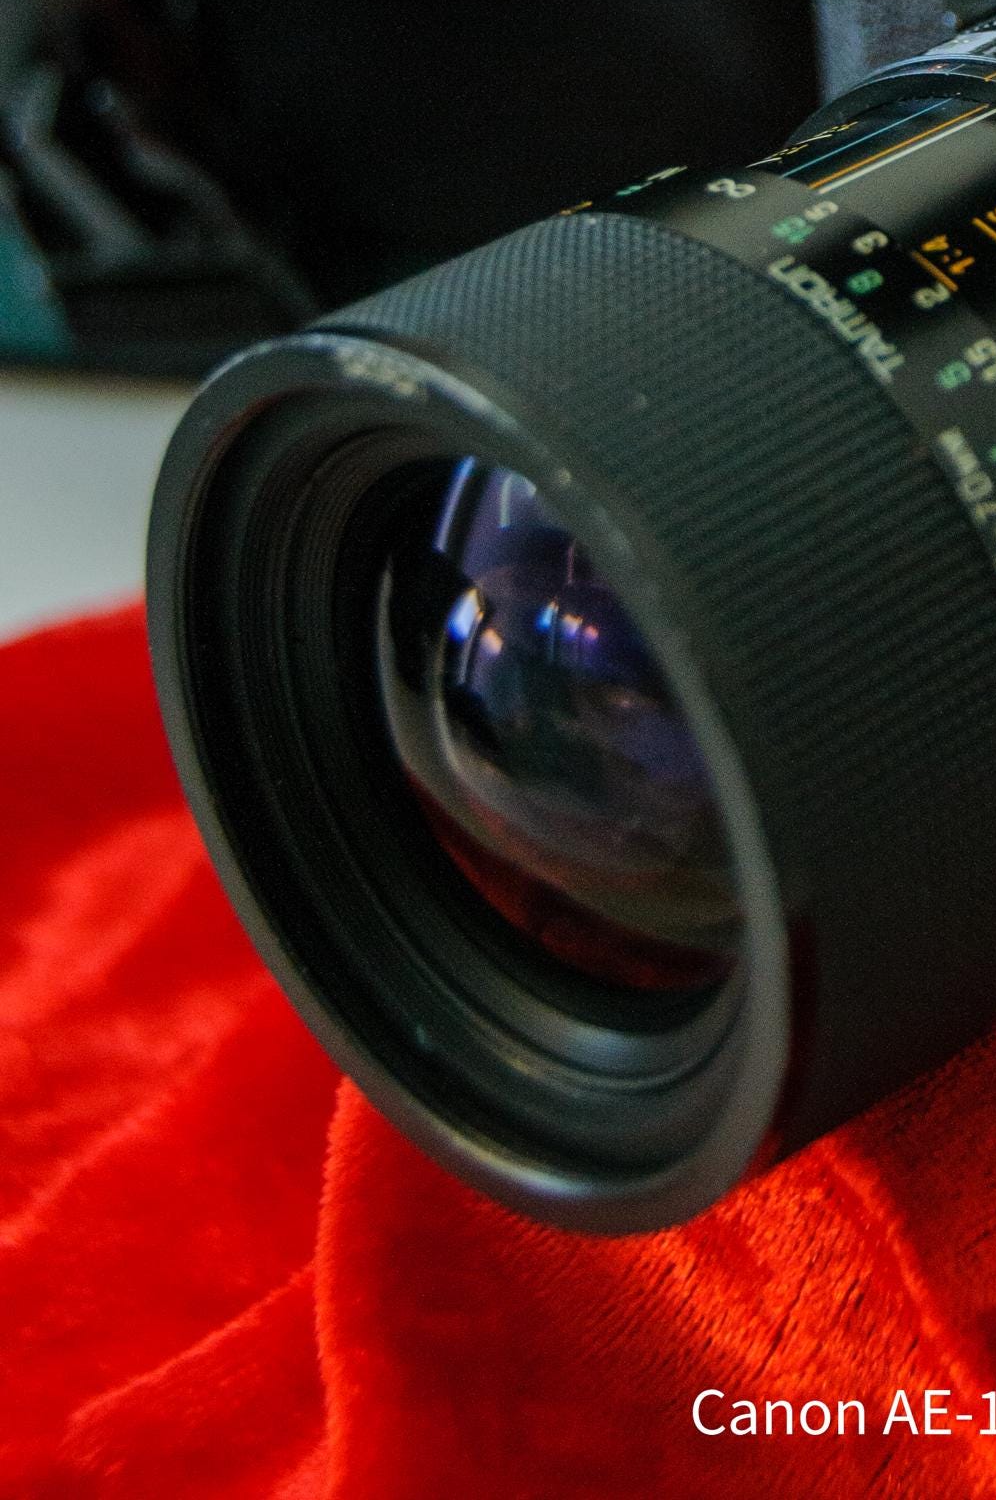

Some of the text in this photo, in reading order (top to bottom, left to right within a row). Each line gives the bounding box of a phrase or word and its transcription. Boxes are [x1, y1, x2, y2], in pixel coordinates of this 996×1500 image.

[852, 231, 889, 255] 3
[921, 235, 976, 275] 1:4
[767, 255, 905, 384] TAMRON
